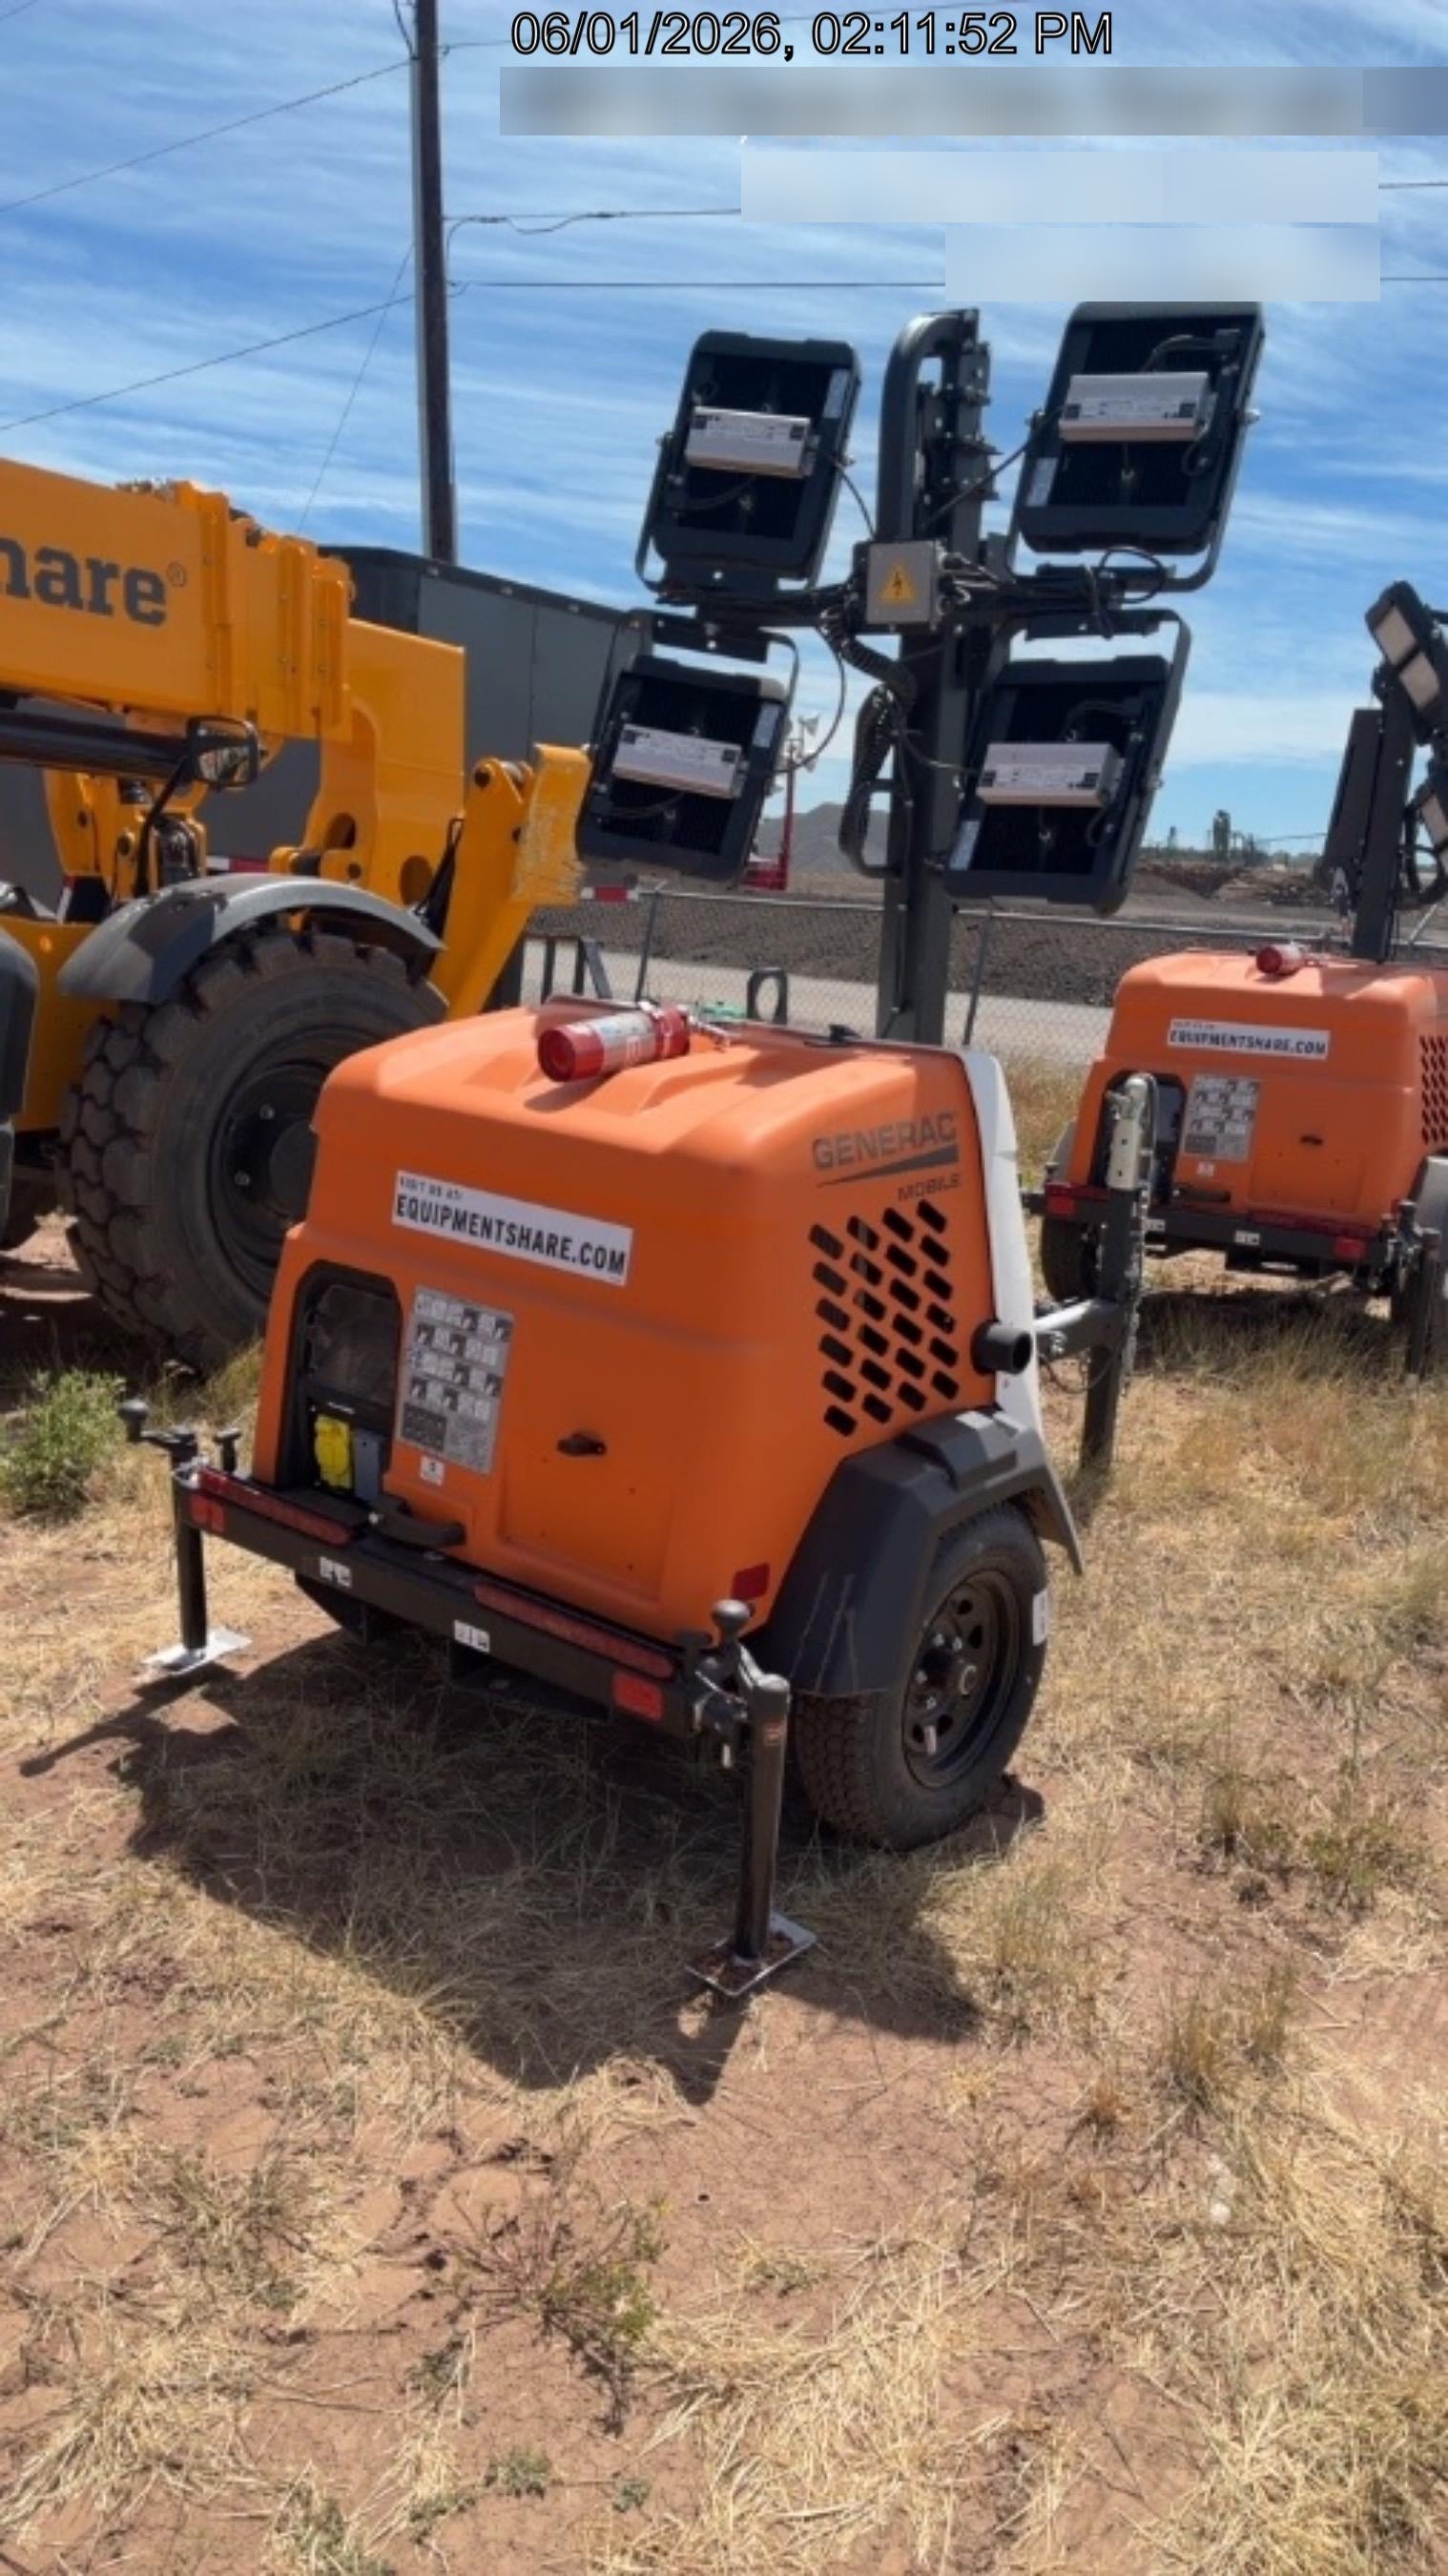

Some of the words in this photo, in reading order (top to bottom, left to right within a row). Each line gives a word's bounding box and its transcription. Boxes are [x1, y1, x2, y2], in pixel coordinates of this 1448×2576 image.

[812, 1111, 957, 1170] GENERAC
[898, 1173, 962, 1202] MOBILE
[397, 1194, 626, 1275] EQUIPMENTSHARE.COM
